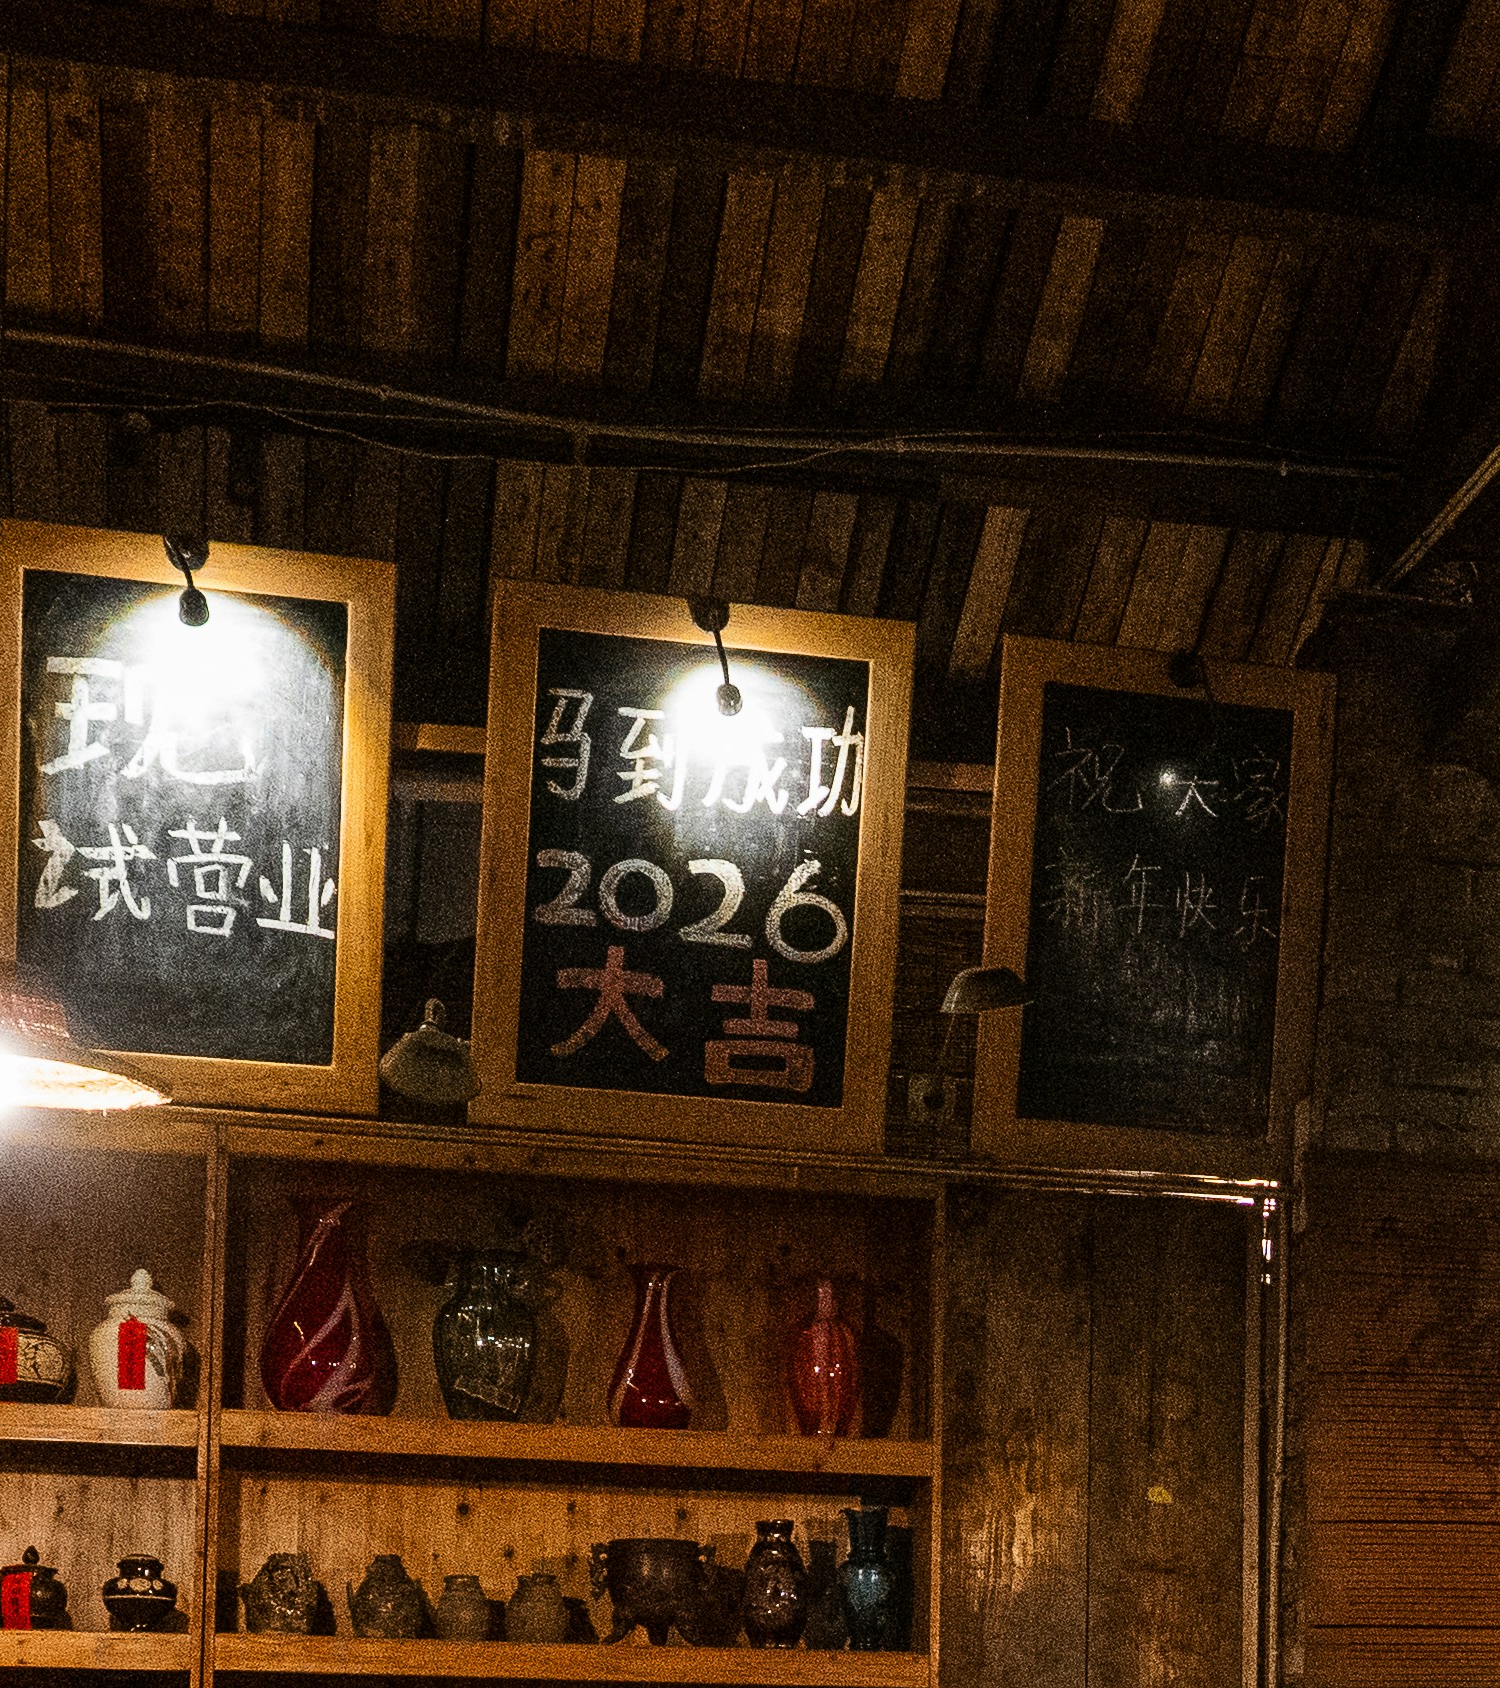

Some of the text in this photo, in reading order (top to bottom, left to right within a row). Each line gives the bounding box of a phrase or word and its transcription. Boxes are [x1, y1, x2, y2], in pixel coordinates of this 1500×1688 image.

[34, 815, 336, 938] 试营业
[534, 847, 850, 965] 2026
[549, 944, 817, 1093] 大吉
